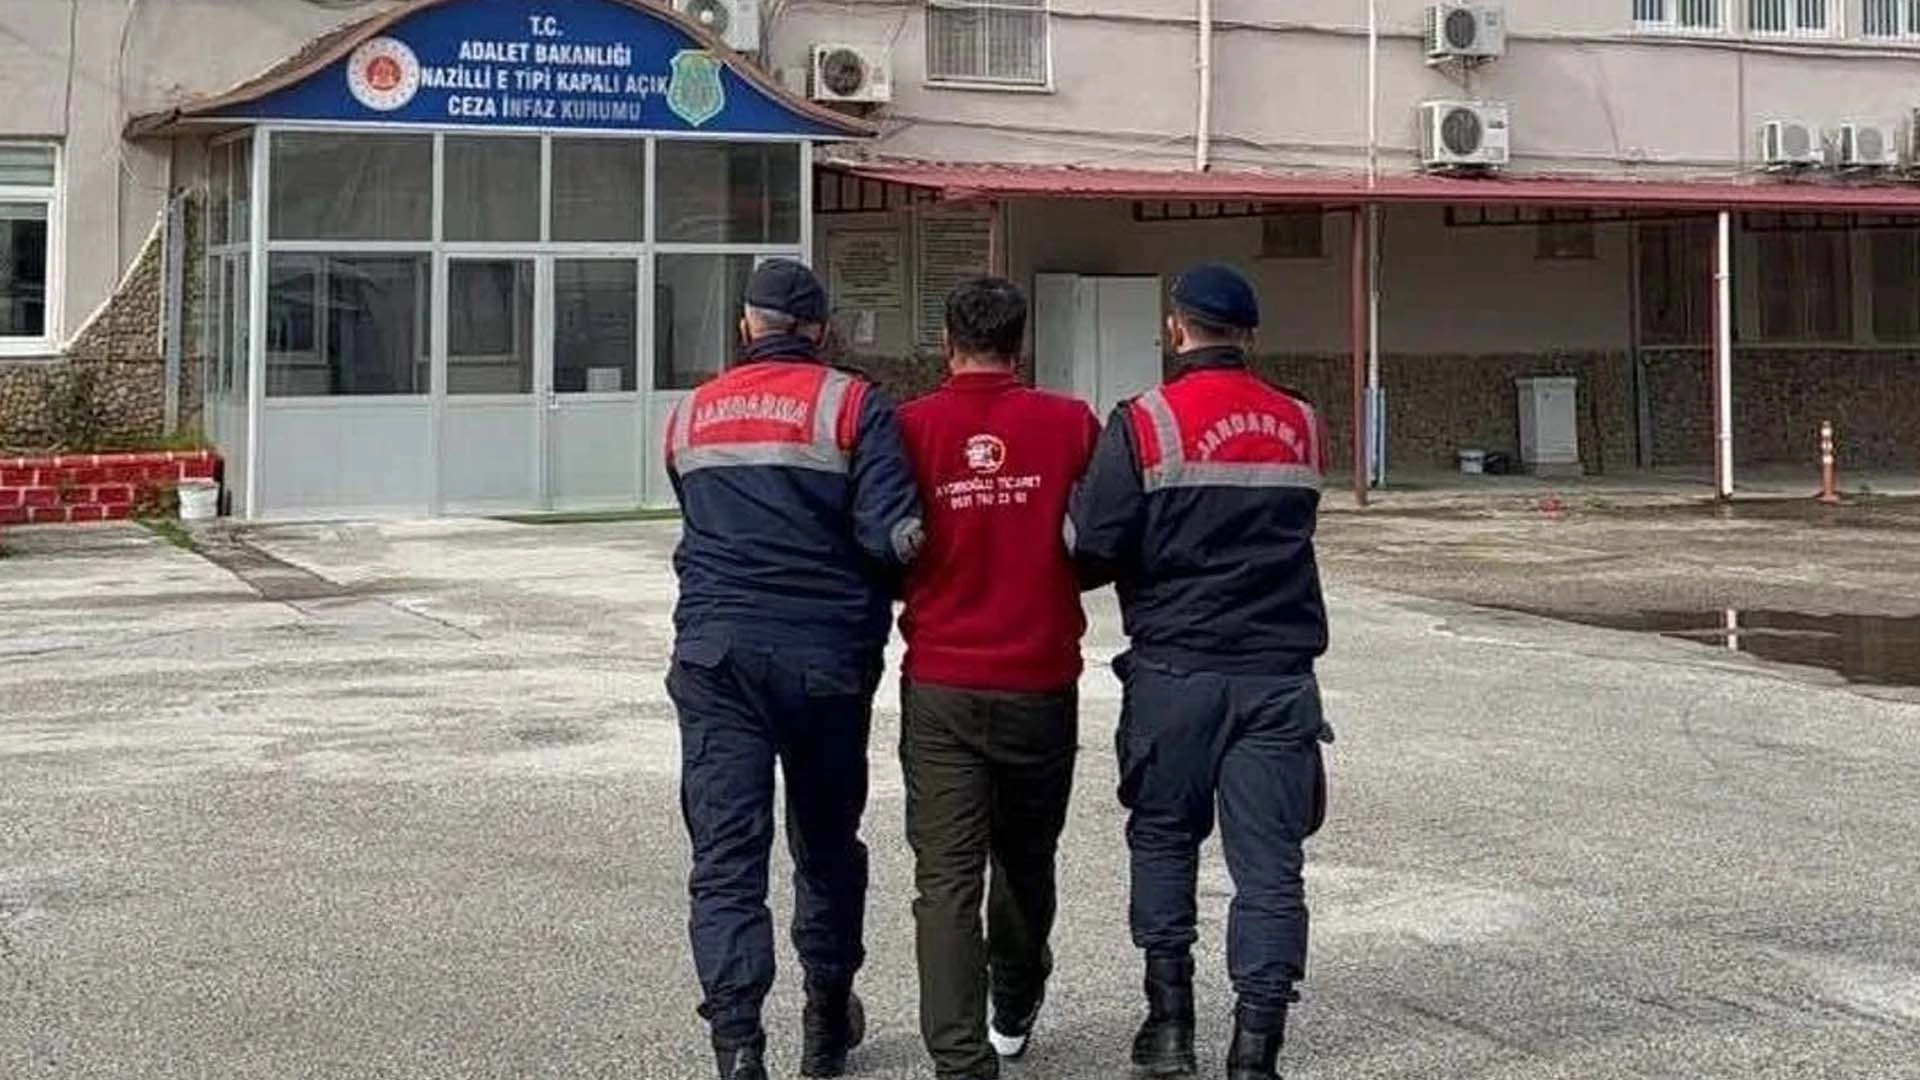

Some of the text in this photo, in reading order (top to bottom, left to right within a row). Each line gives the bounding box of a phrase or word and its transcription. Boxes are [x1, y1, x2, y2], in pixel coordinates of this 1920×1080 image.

[529, 16, 563, 36] T.C.
[459, 41, 631, 66] ADALET BAKANLIĞI
[421, 66, 669, 99] NAZİLLİ E TİPİ KAPALI AÇIK
[448, 96, 641, 121] CEZA İNFAZ KURUMU
[695, 392, 809, 430] JANDARMA
[1197, 411, 1304, 460] JANDARMA
